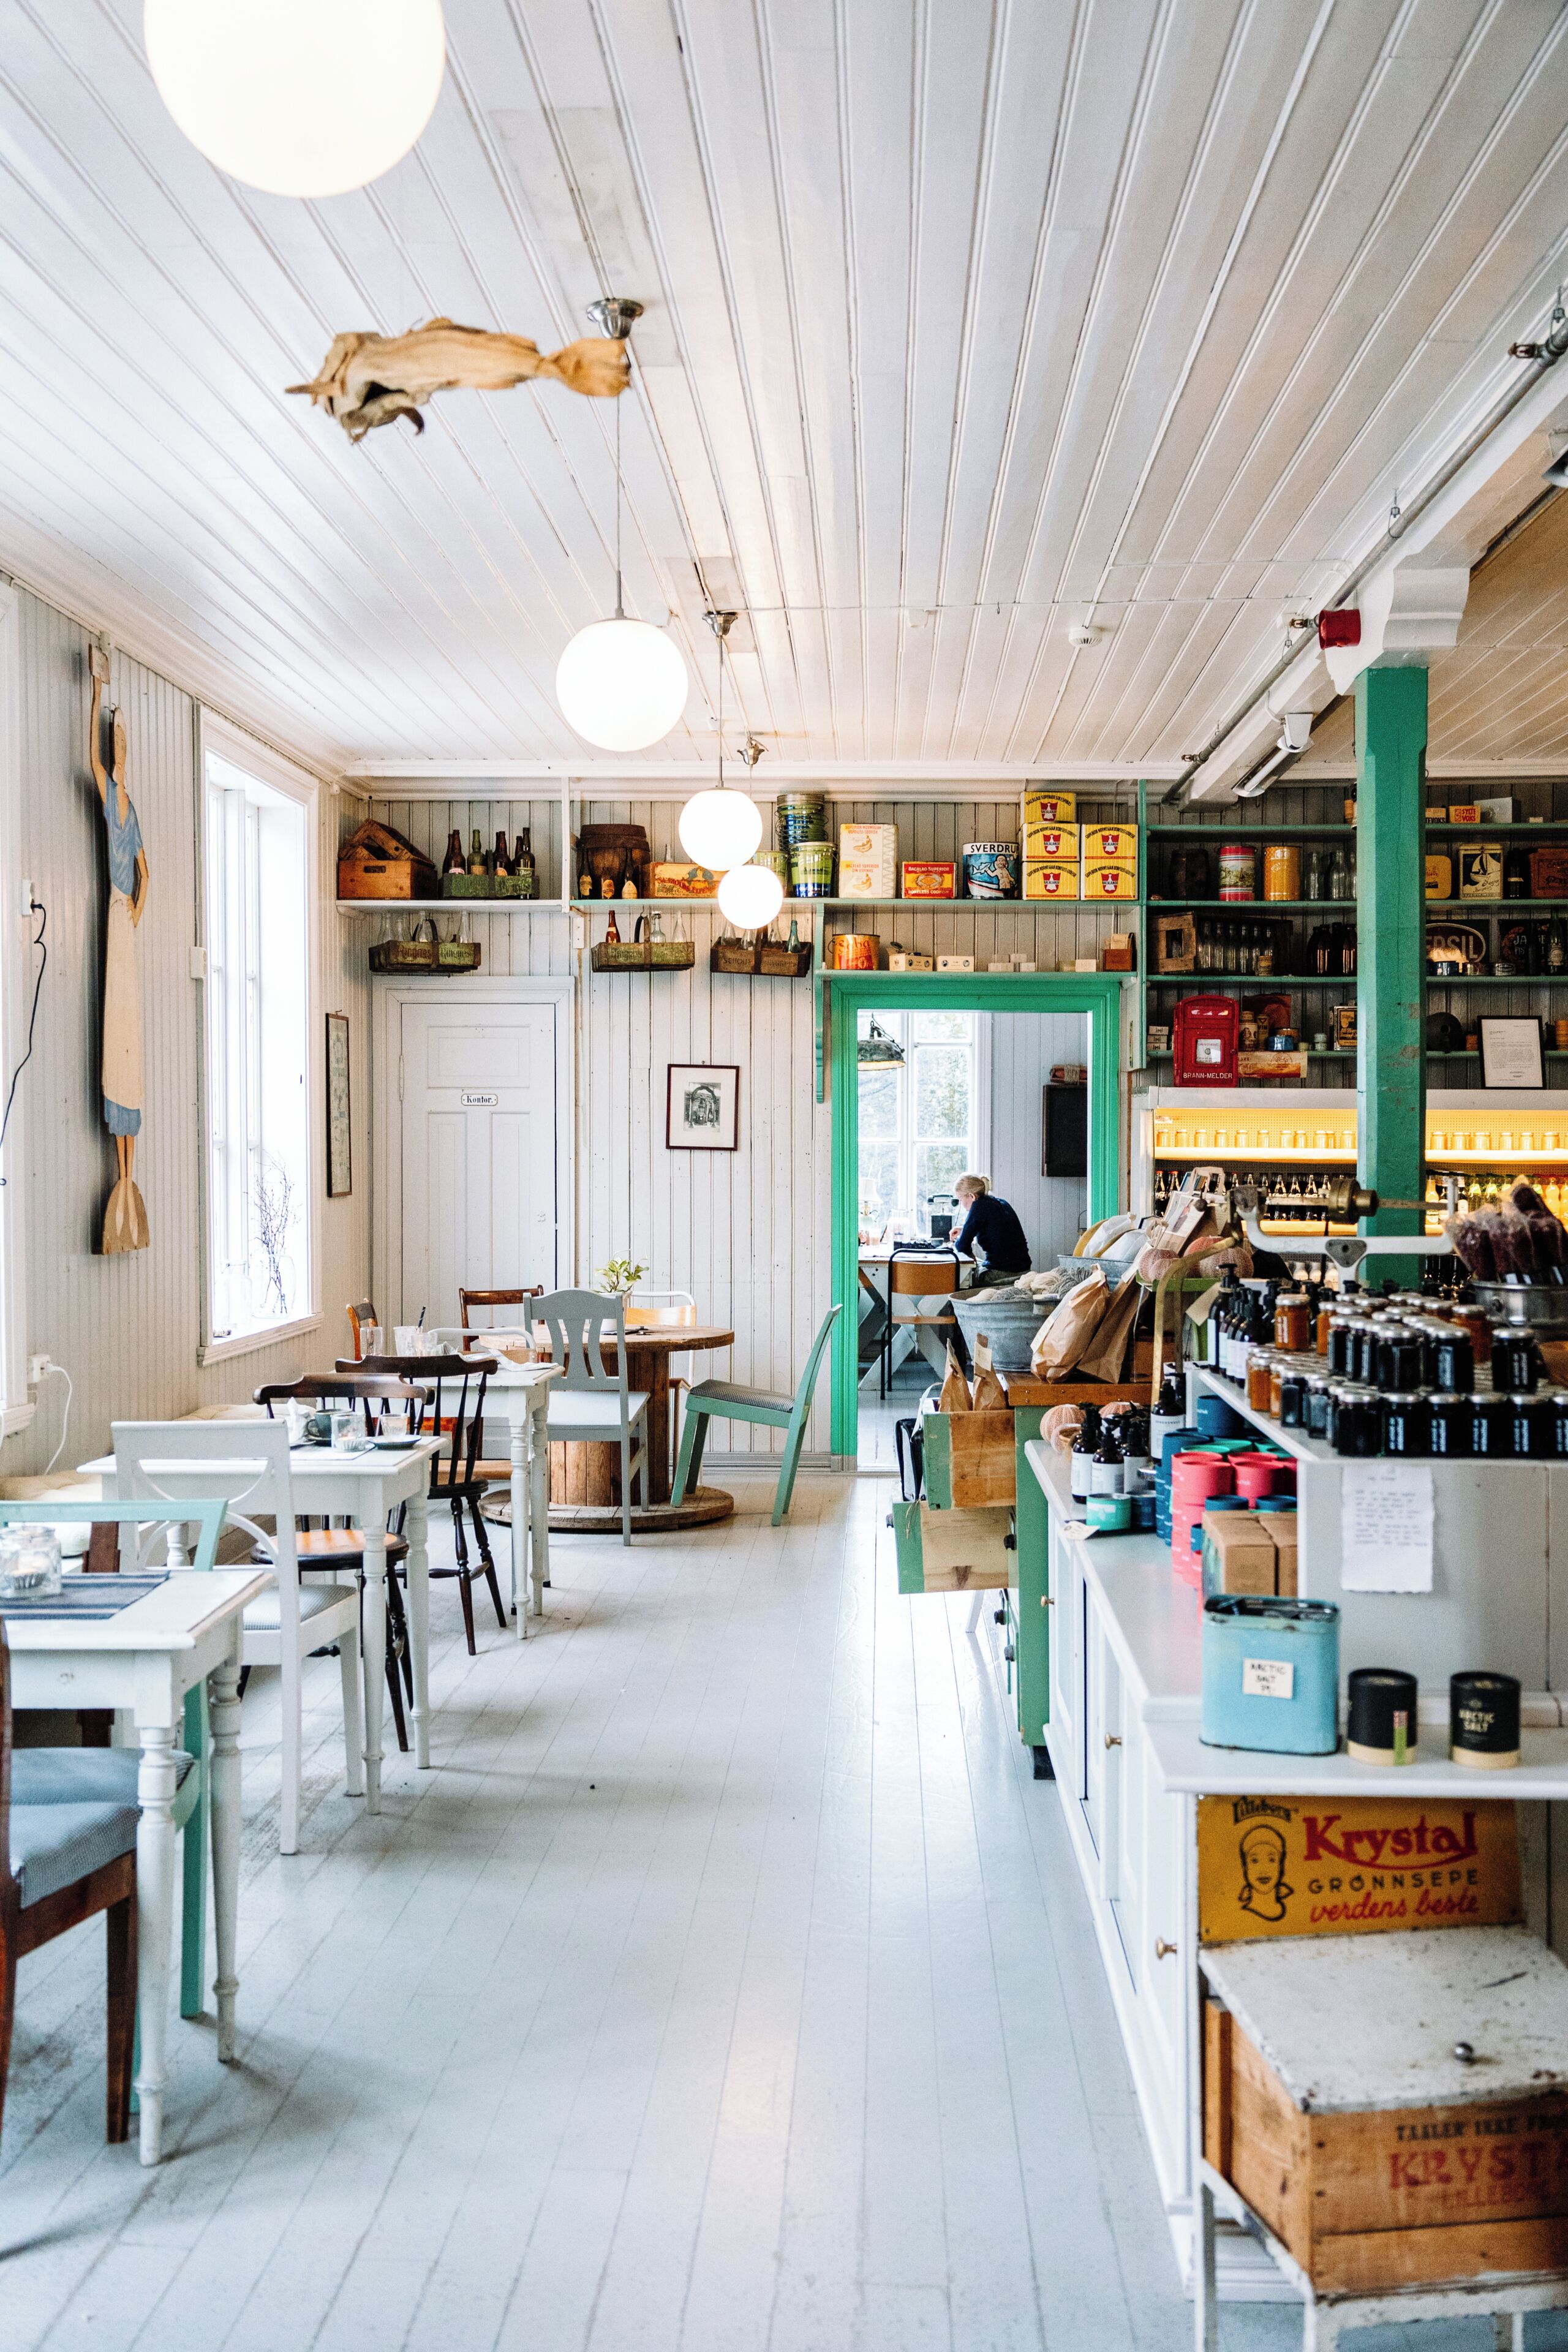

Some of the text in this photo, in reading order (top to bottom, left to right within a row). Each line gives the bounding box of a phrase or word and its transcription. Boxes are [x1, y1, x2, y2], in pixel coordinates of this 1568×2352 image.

[440, 946, 471, 960] Ringnes
[1426, 935, 1479, 959] ERSIL
[1459, 1709, 1494, 1724] ARCTIC
[1464, 1721, 1488, 1733] SALT
[1302, 1811, 1478, 1870] Krystal
[1308, 1869, 1479, 1894] GRØNNSEPE
[1310, 1887, 1480, 1923] verdens beste
